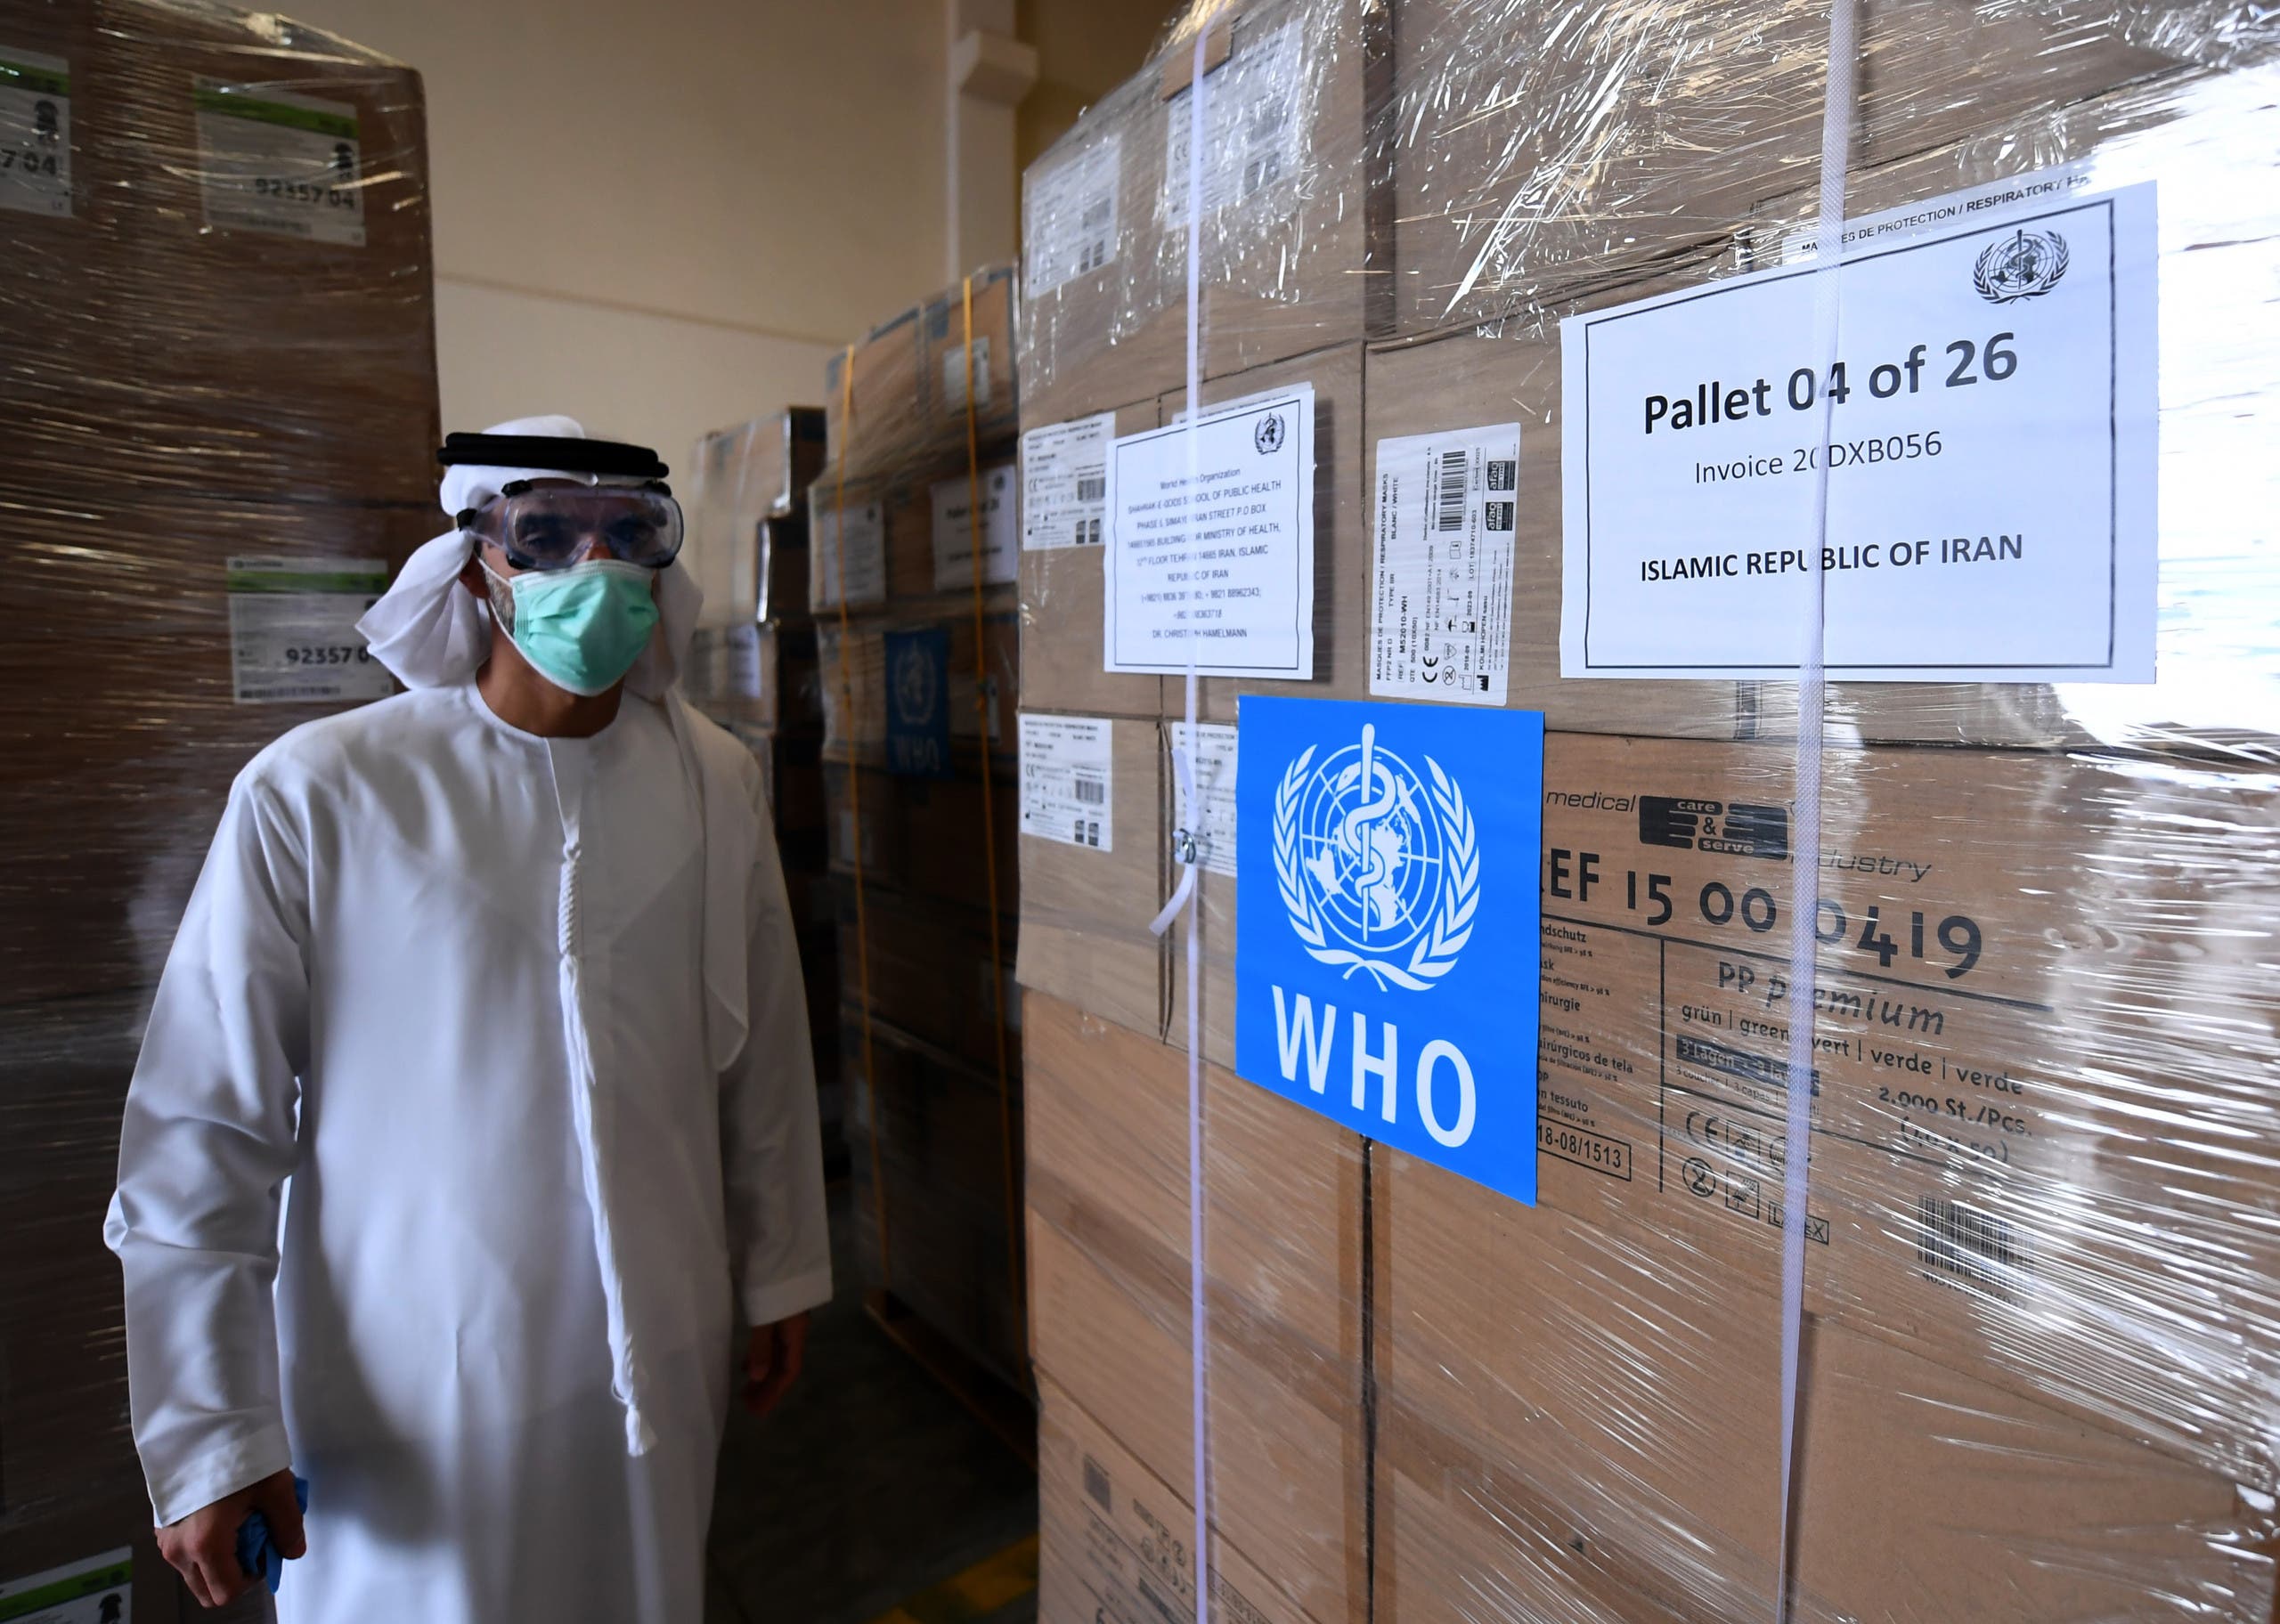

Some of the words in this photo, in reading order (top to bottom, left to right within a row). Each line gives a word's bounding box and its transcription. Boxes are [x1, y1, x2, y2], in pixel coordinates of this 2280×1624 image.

[1858, 226, 1875, 241] DE
[1877, 207, 1956, 234] PROTECTION
[1966, 180, 2062, 212] RESPIRATORY
[1644, 378, 1771, 434] Pallet
[1787, 361, 1851, 411] 04
[1869, 344, 1927, 399] of
[1945, 331, 2018, 388] 26
[1696, 454, 1783, 484] Invoice
[1212, 490, 1223, 499] OF
[1224, 485, 1250, 498] PUBLIC
[1250, 480, 1282, 493] HEALTH
[1381, 473, 1389, 503] MASKS
[1209, 508, 1234, 520] STREET
[1250, 503, 1267, 515] BOX
[1236, 526, 1247, 536] OF
[1380, 505, 1388, 564] RESPIRATORY
[1238, 544, 1269, 557] ISLAMIC
[1641, 553, 1738, 582] ISLAMIC
[1747, 544, 1880, 575] REPUBLIC
[1889, 540, 1930, 567] OF
[1942, 534, 2023, 564] IRAN
[1212, 569, 1229, 580] IRAN
[1202, 627, 1248, 639] HAMELMANN
[1545, 792, 1637, 813] medical
[1677, 800, 1715, 813] care
[1702, 816, 1717, 836] &
[1702, 839, 1755, 855] serve
[1542, 848, 1600, 903] EF
[1627, 870, 1673, 926] 15
[1699, 881, 1777, 933] 00
[1816, 897, 1983, 979] 0419
[1540, 923, 1587, 944] ndschutz
[1718, 961, 1755, 993] PP
[1765, 972, 1945, 1035] pemium
[1539, 1037, 1591, 1062] irúrgicos
[1593, 1052, 1608, 1068] de
[1612, 1058, 1633, 1075] tela
[1682, 1003, 1722, 1026] grün
[1739, 1018, 1790, 1042] green
[1811, 1035, 1850, 1058] vert
[1871, 1048, 1933, 1076] verde
[1957, 1068, 2024, 1096] verde
[1693, 1042, 1736, 1070] Lagen
[1272, 985, 1477, 1148] WHO
[1550, 1091, 1589, 1113] tessuto
[1878, 1086, 1939, 1114] 2.000
[1945, 1098, 2033, 1138] St./Pcs.
